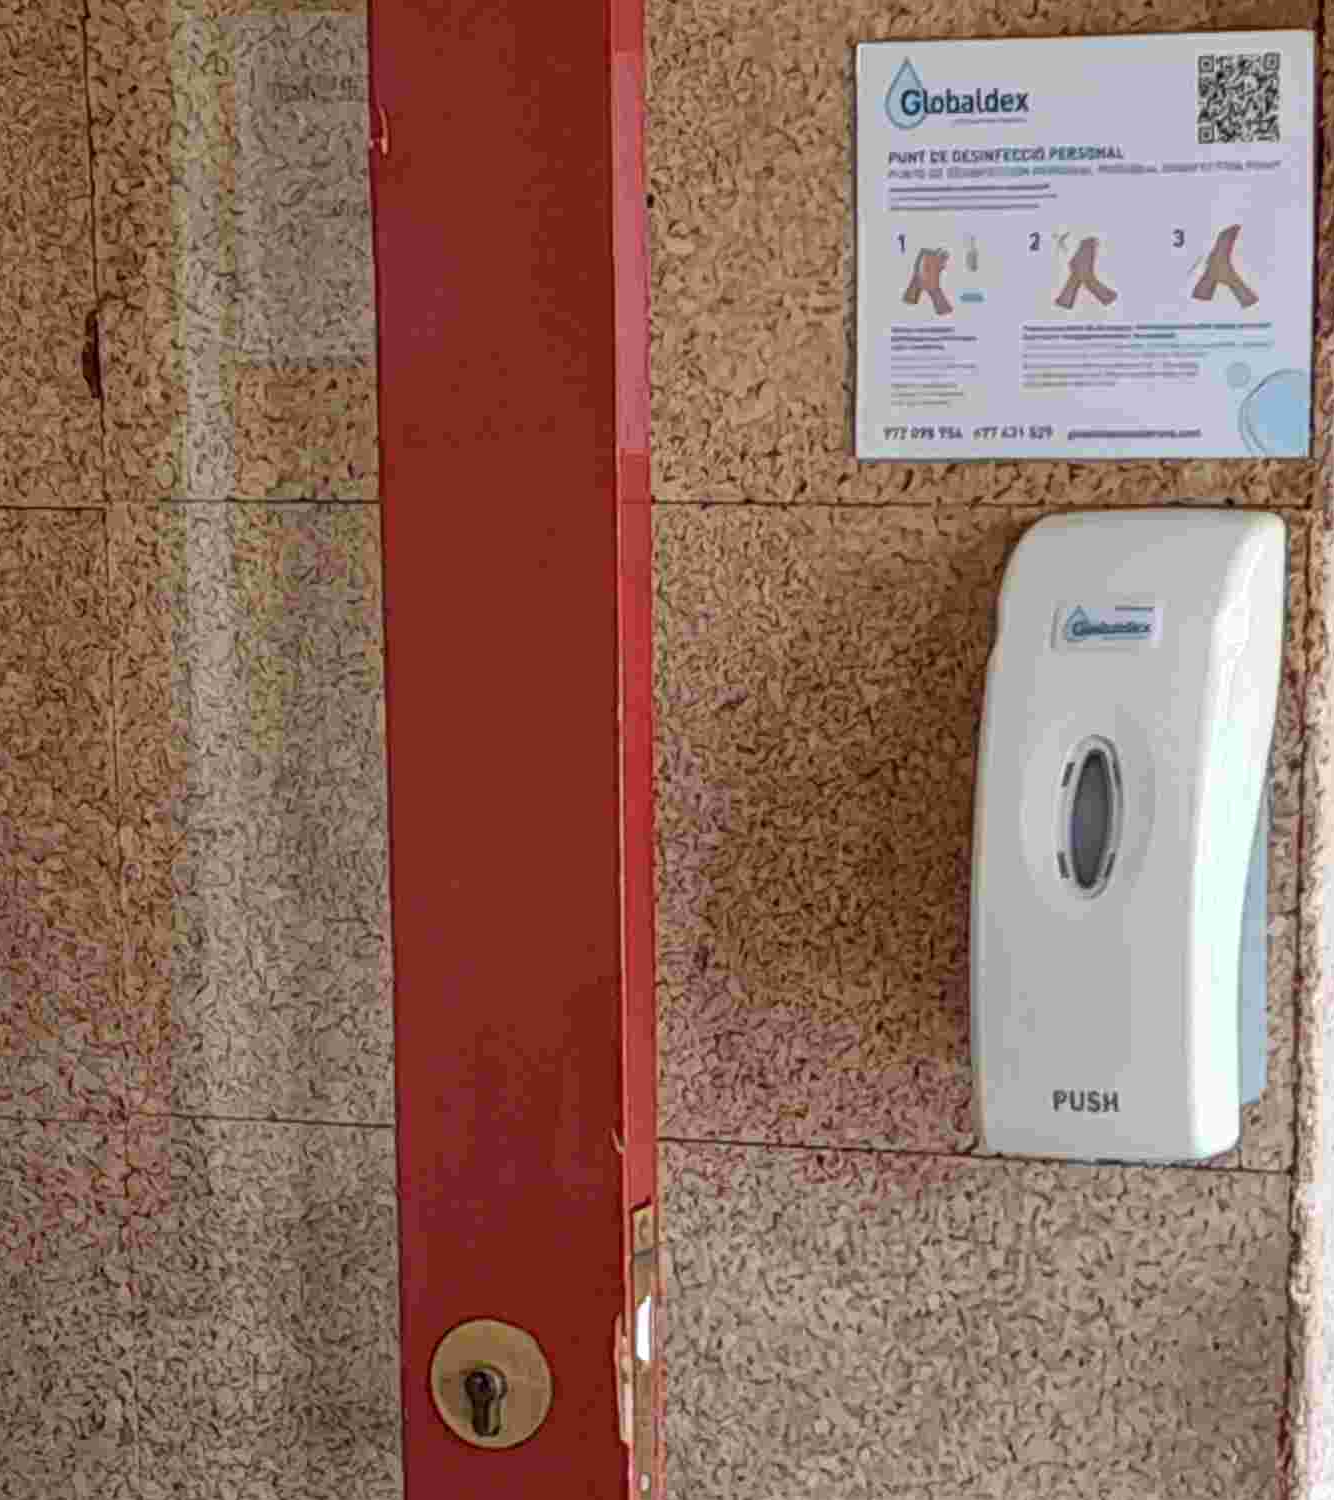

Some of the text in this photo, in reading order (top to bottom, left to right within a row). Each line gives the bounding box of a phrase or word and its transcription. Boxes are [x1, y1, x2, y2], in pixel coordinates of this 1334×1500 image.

[901, 87, 1029, 116] Globaldex
[896, 233, 907, 253] 1
[1028, 231, 1041, 251] 2
[1172, 228, 1186, 248] 3
[1052, 1089, 1121, 1113] PUSH
